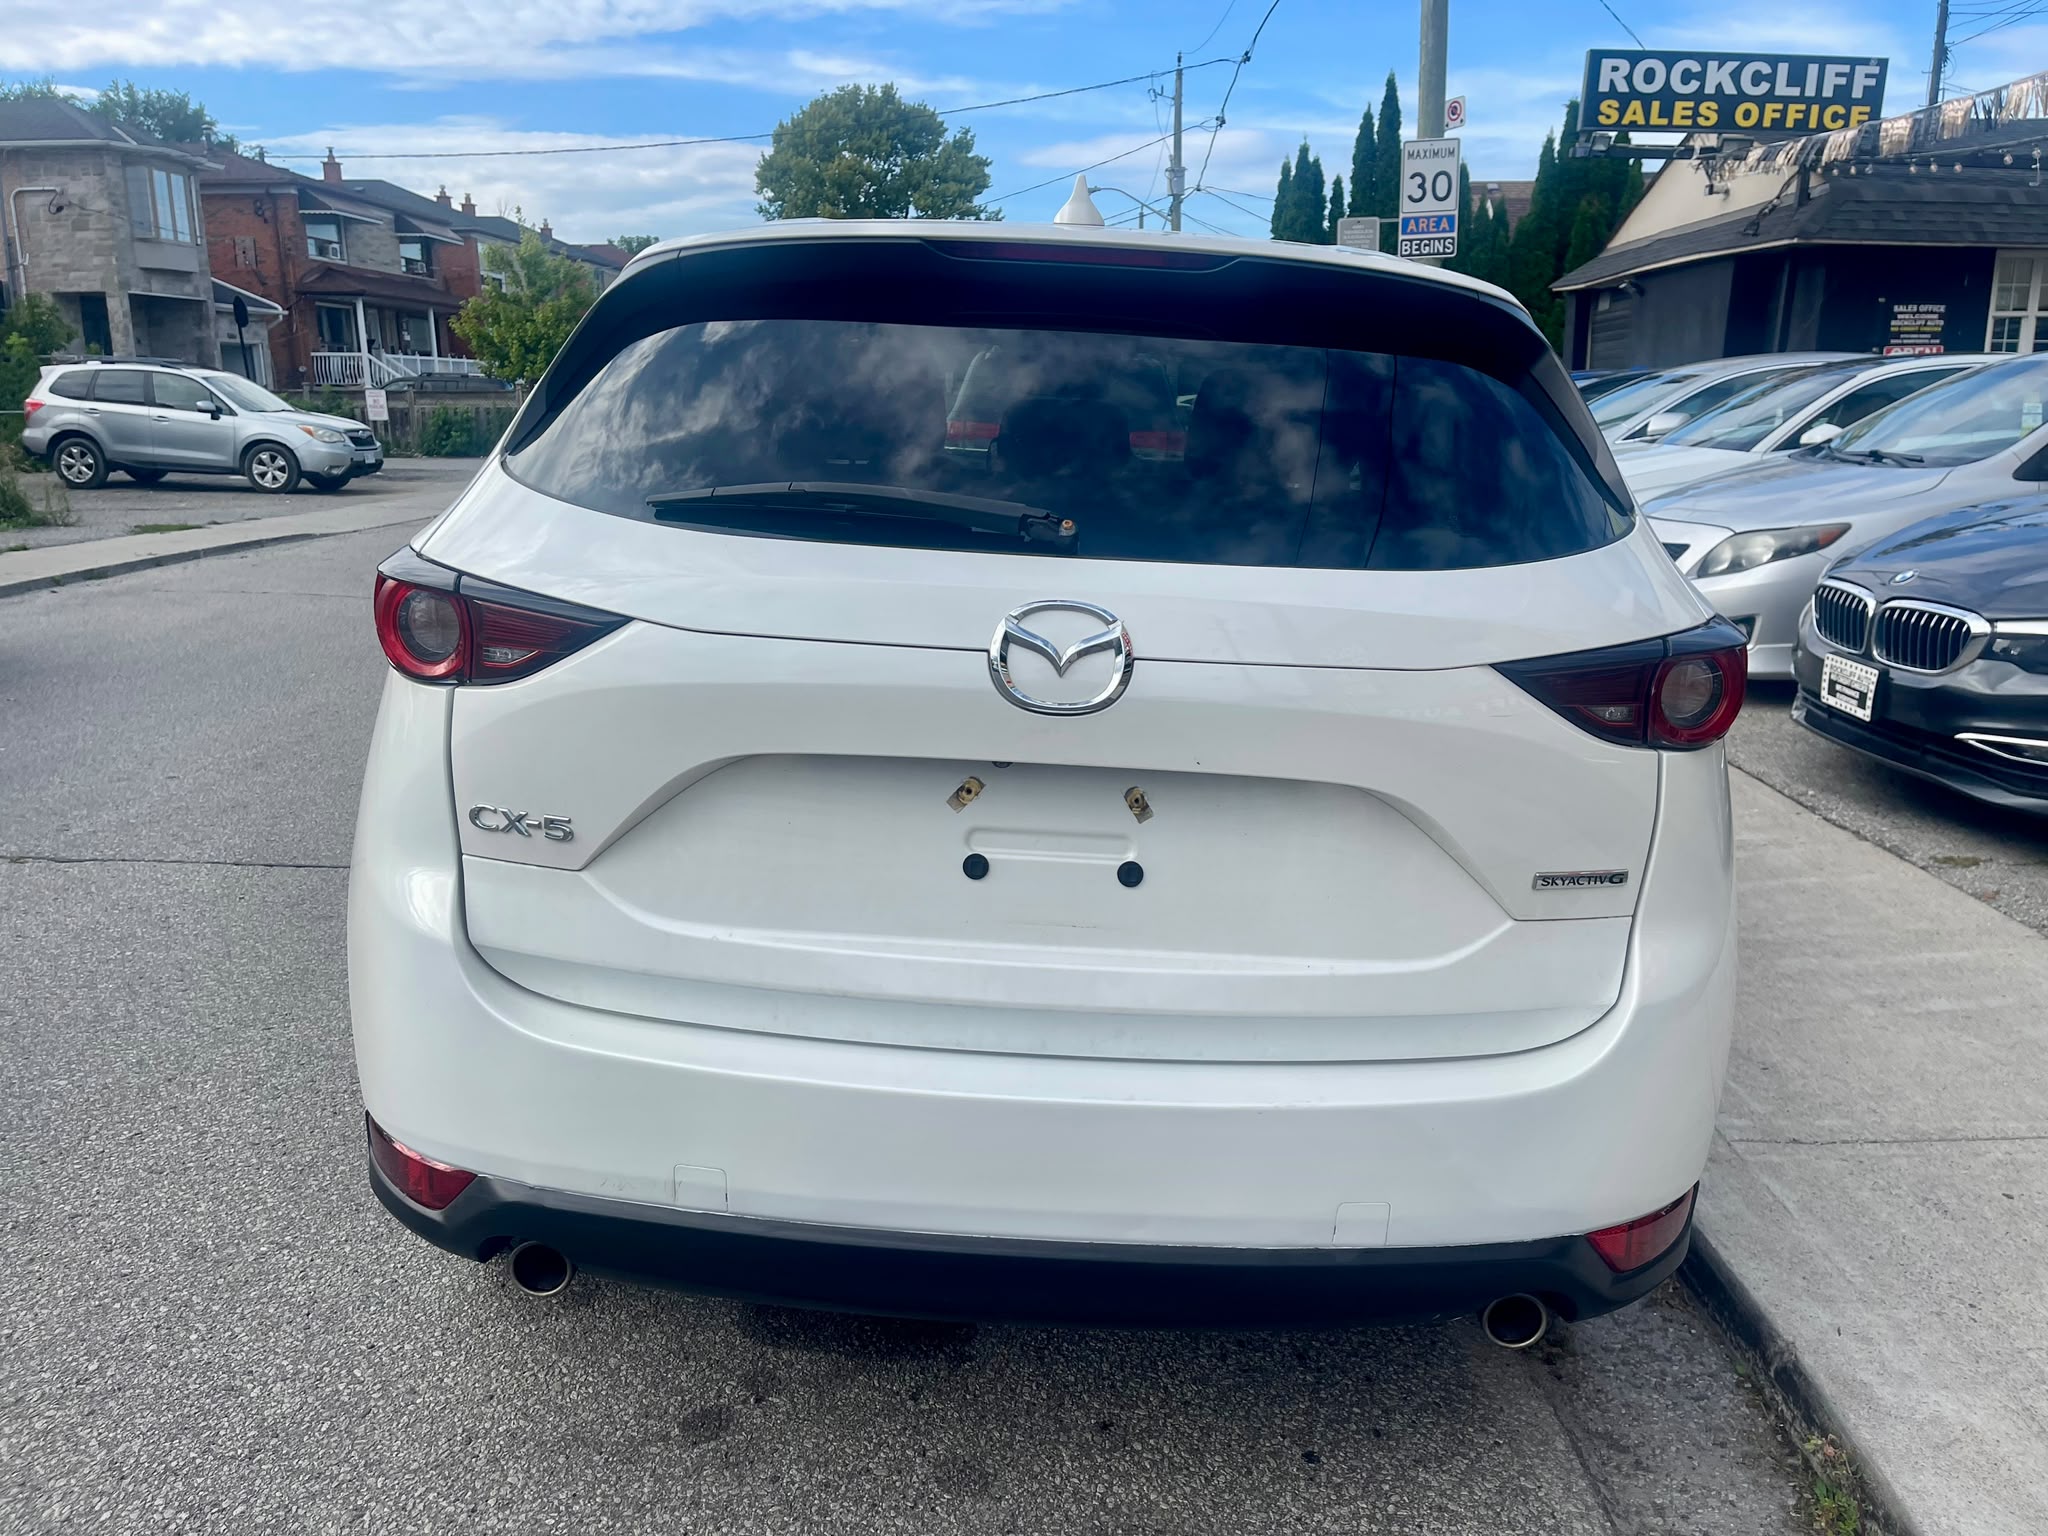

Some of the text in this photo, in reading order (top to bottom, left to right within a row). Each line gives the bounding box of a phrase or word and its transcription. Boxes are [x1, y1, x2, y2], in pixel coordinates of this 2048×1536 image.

[1597, 57, 1881, 99] ROCKCLIFF
[1597, 99, 1872, 130] SALES OFFICE
[1407, 146, 1456, 161] MAXIMUM
[1407, 169, 1453, 204] 30
[1406, 217, 1450, 233] AREA
[1401, 238, 1454, 256] BEGINS
[1893, 304, 1946, 312] SALES OFFICE
[468, 803, 575, 842] CX-5
